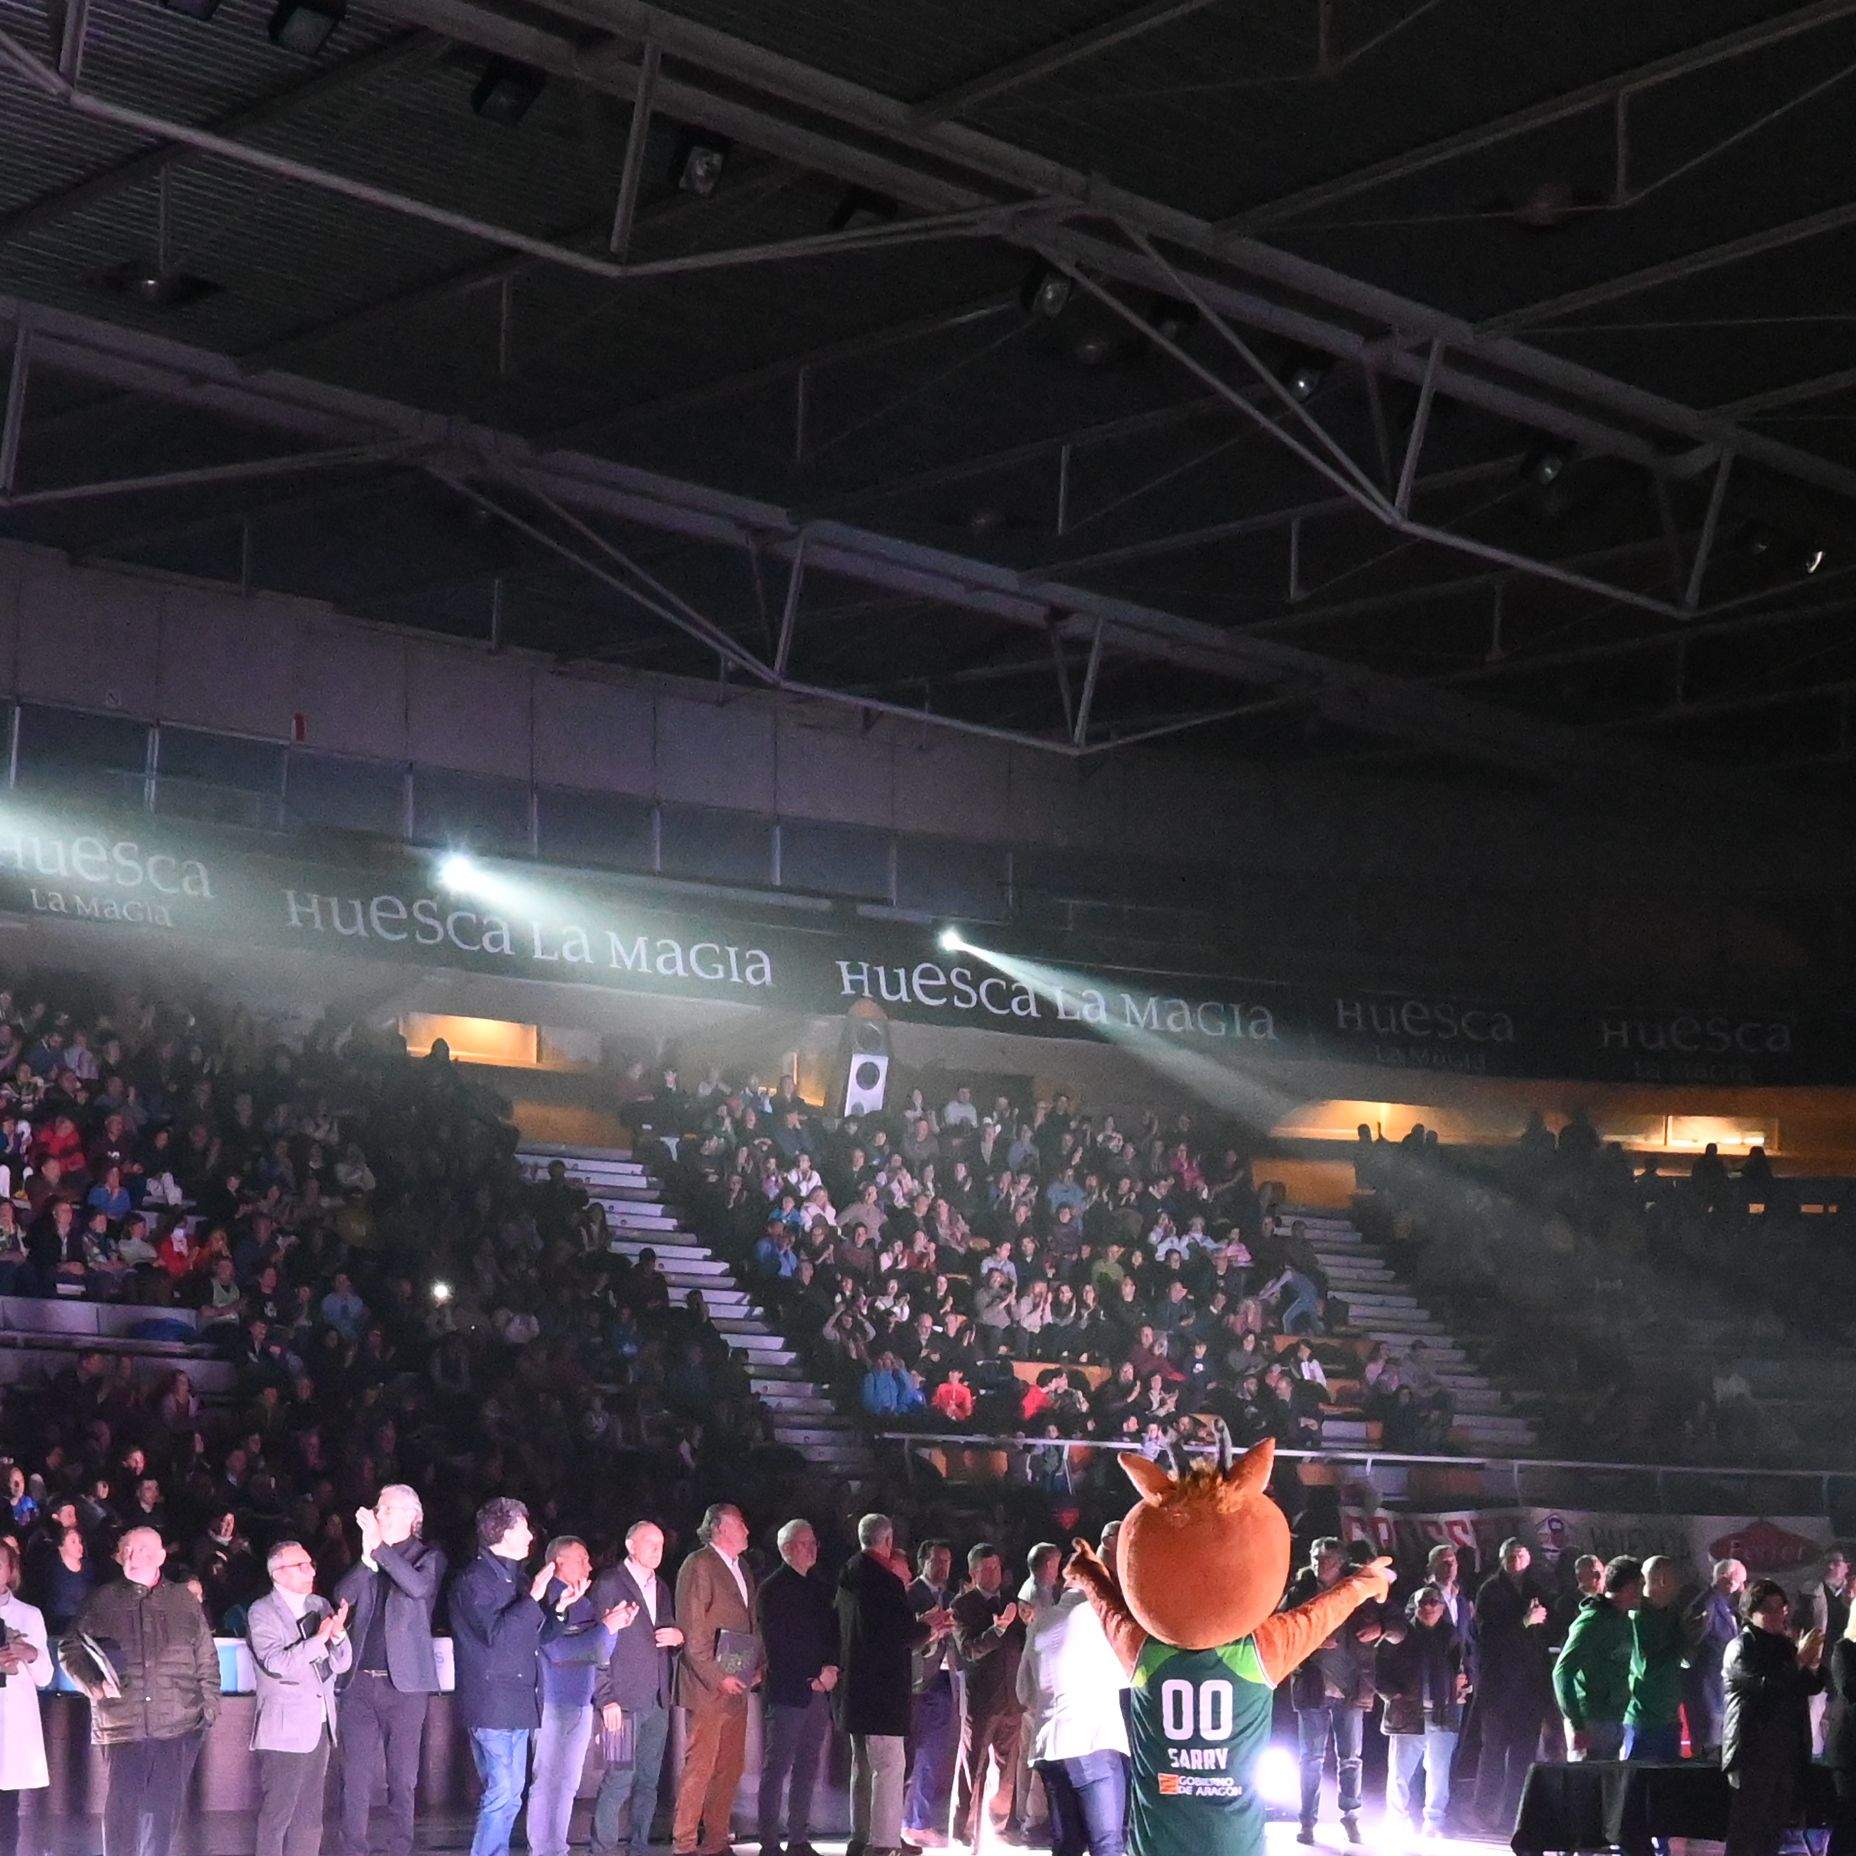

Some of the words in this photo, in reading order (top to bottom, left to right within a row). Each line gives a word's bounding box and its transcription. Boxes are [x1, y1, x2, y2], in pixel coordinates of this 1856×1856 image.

[30, 888, 68, 913] La
[283, 889, 515, 954] Huesca
[530, 921, 593, 963] La
[835, 960, 1042, 1018] Huesca
[1056, 987, 1108, 1025] La
[1336, 998, 1516, 1043] Huesca
[1601, 1015, 1793, 1054] Huesca
[1162, 1679, 1233, 1741] 00
[1179, 1786, 1192, 1795] DE
